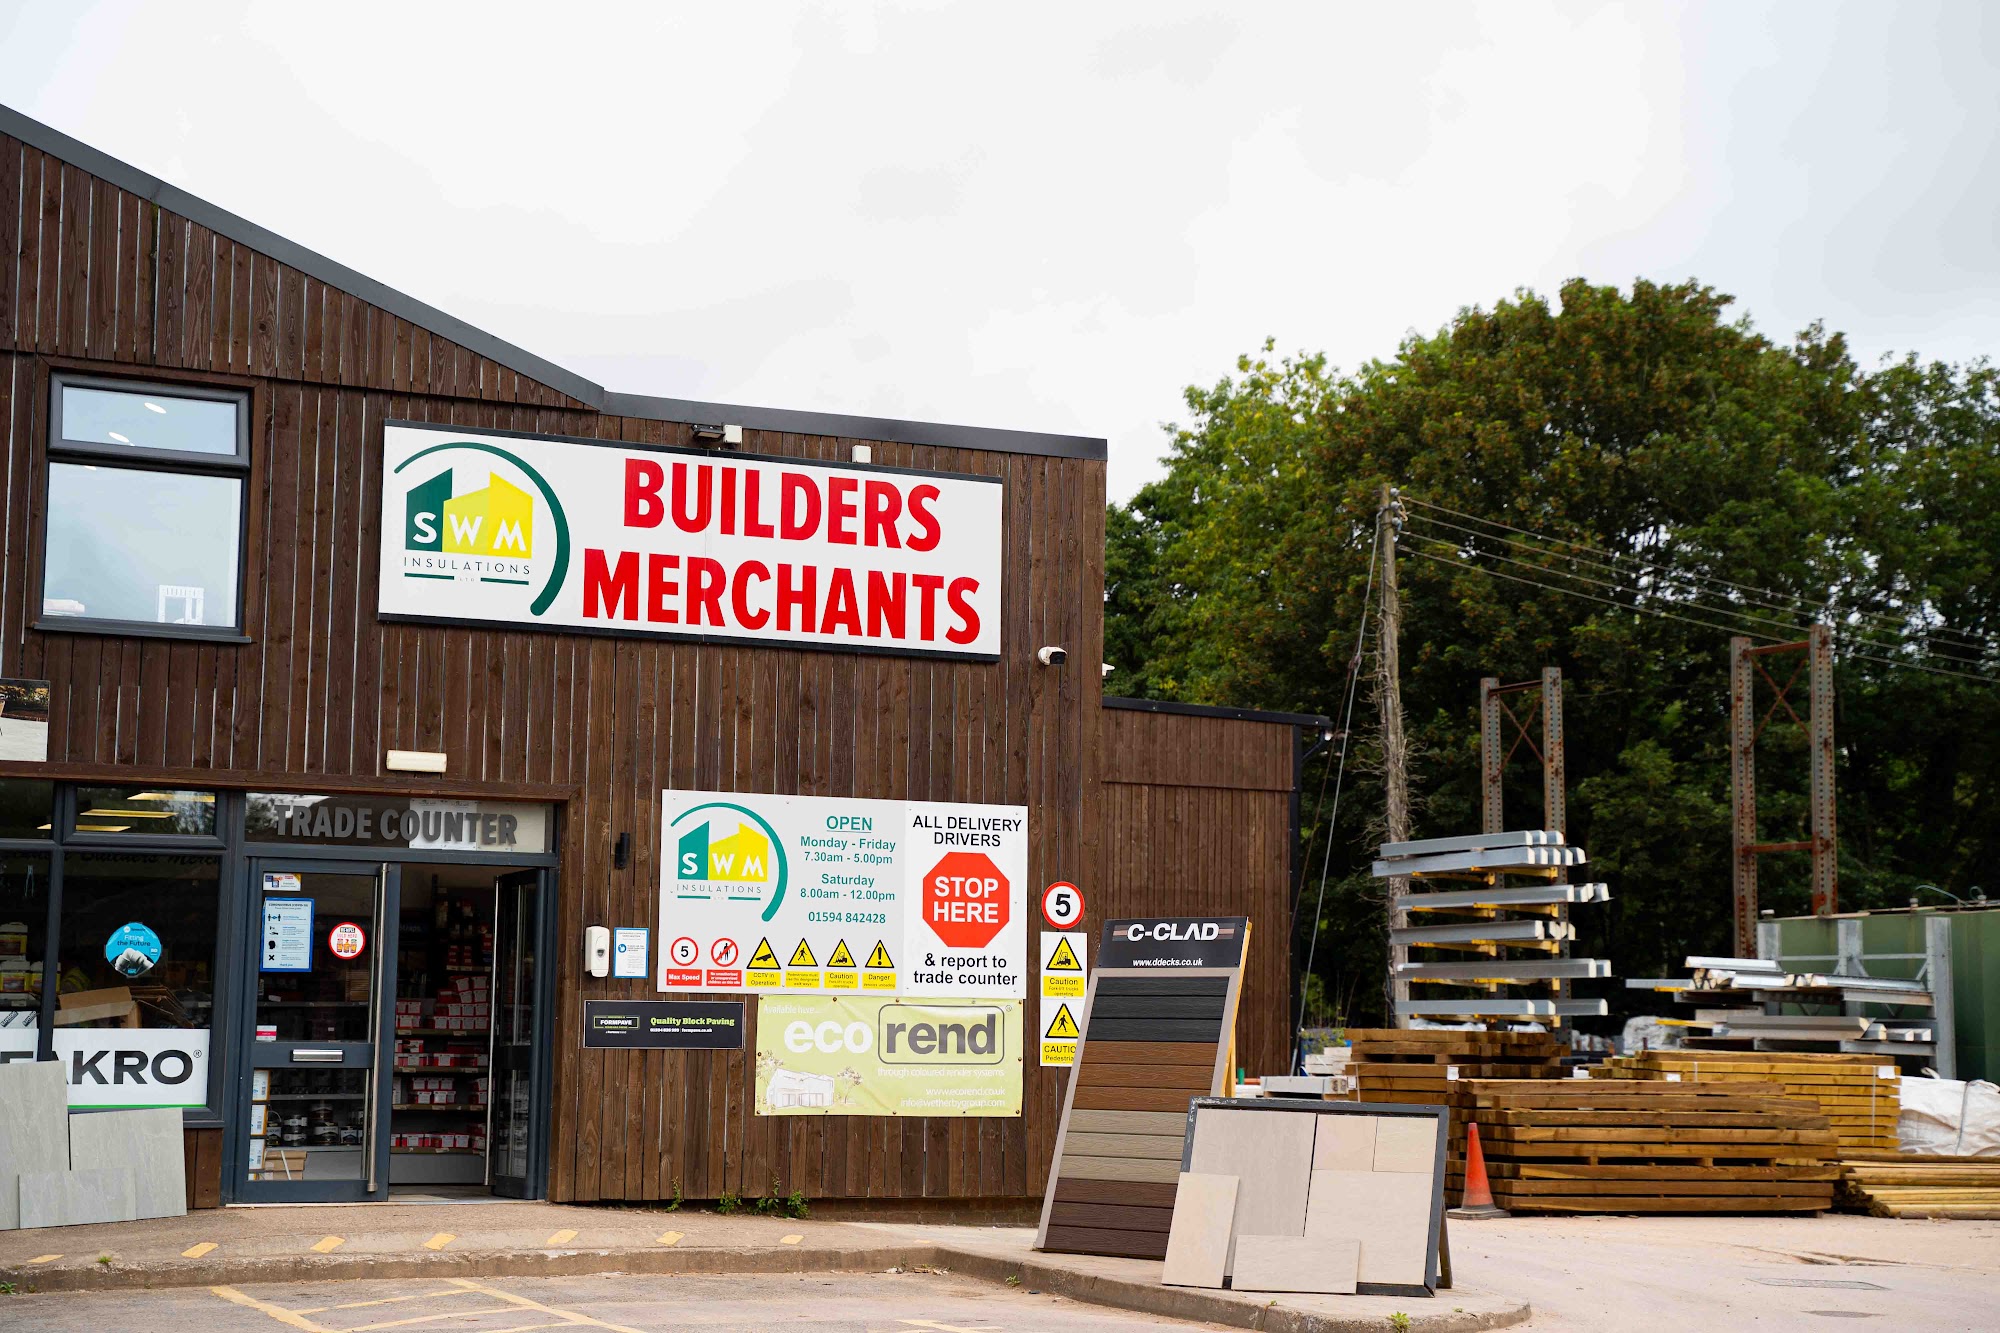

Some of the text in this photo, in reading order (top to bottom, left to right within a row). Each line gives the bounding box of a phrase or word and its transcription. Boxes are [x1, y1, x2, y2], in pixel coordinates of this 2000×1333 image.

[624, 458, 941, 552] BUILDERS
[413, 511, 527, 552] SWM
[404, 557, 530, 575] INSULATIONS
[583, 548, 981, 645] MERCHANTS
[274, 805, 518, 845] TRADE COUNTER
[826, 815, 872, 831] OPEN
[913, 815, 1022, 832] ALL DELIVERY
[800, 836, 848, 850] Monday
[859, 838, 896, 853] Friday
[934, 832, 1001, 847] DRIVERS
[682, 852, 764, 878] SWM
[804, 851, 843, 862] 7.30am
[853, 853, 893, 866] 5.00pm
[821, 873, 875, 888] Saturday
[934, 876, 999, 899] STOP
[676, 884, 762, 894] INSULATIONS
[800, 888, 839, 899] 8.00am
[850, 889, 895, 902] 12.00pm
[933, 901, 999, 924] HERE
[1055, 893, 1071, 917] 5
[808, 911, 886, 924] 01594 842428
[124, 934, 144, 942] Fitting
[1127, 922, 1220, 942] C-CLAD
[680, 945, 689, 957] 5
[925, 953, 1007, 971] & report to
[1132, 957, 1203, 966] www.ddecks.co.uk
[913, 970, 1018, 985] trade counter
[1049, 977, 1078, 986] Caution
[650, 1017, 735, 1027] Quality Block Paving
[784, 1014, 996, 1055] eco rend
[1044, 1045, 1076, 1053] CAUTIO
[1, 1050, 193, 1085] KRO
[877, 1067, 1005, 1078] through coloured render systems
[926, 1086, 1005, 1096] www.ecorend.co.uk
